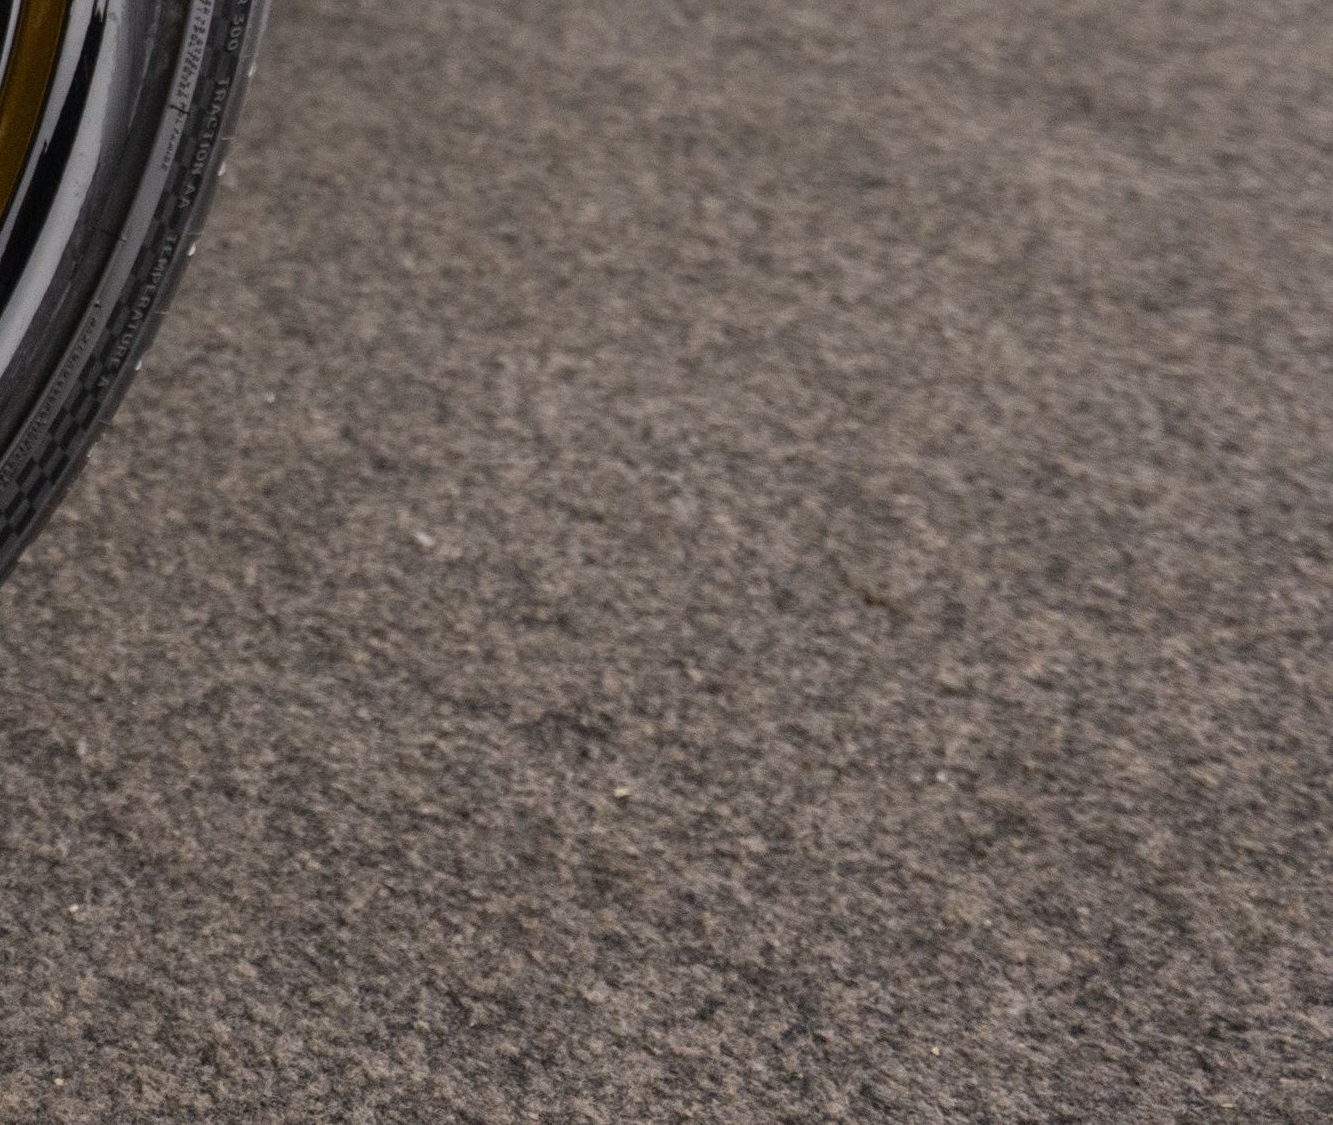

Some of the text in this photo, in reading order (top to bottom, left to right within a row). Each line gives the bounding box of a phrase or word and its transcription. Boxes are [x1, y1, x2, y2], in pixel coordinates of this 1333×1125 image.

[226, 12, 246, 53] 300
[191, 76, 231, 177] TRACTION
[108, 233, 179, 368] TEMPERATURE
